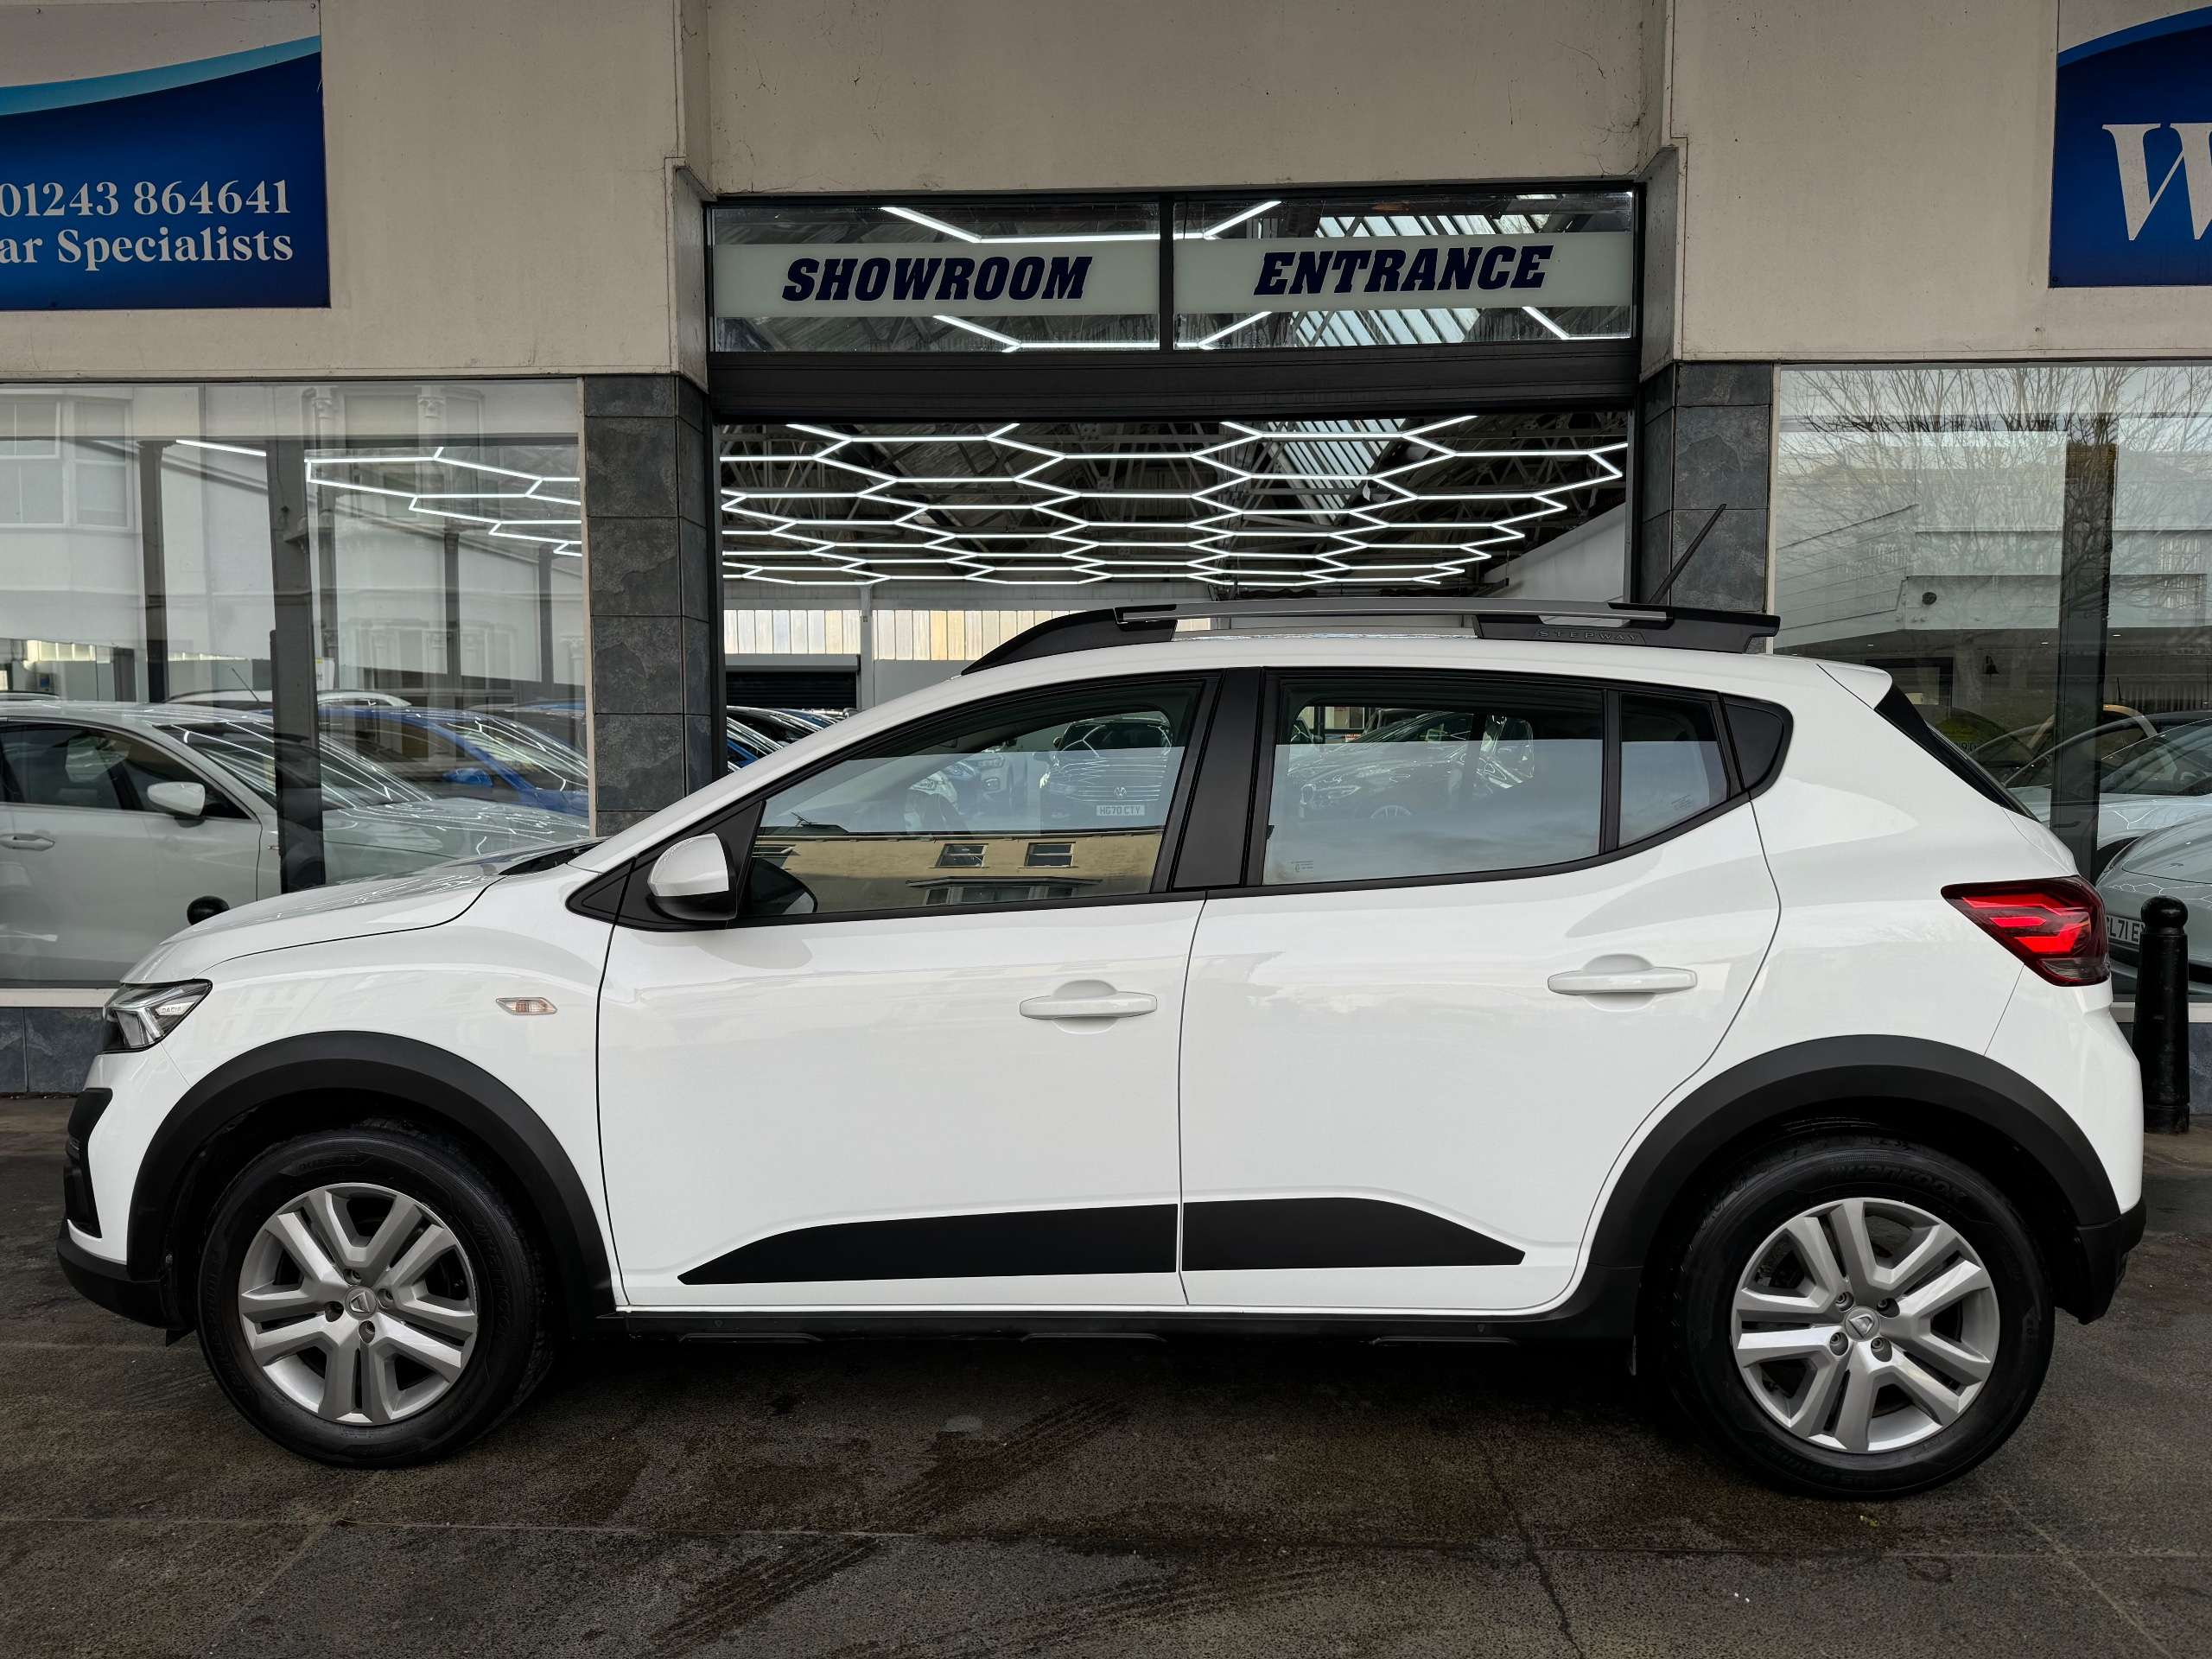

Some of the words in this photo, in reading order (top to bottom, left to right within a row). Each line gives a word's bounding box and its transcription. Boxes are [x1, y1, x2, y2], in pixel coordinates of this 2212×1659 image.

[0, 181, 119, 217] 01243
[134, 179, 291, 215] 864641
[57, 226, 294, 271] Specialists
[781, 256, 1093, 302] SHOWROOM
[1253, 245, 1554, 296] ENTRANCE
[1537, 630, 1638, 642] STEPWAY
